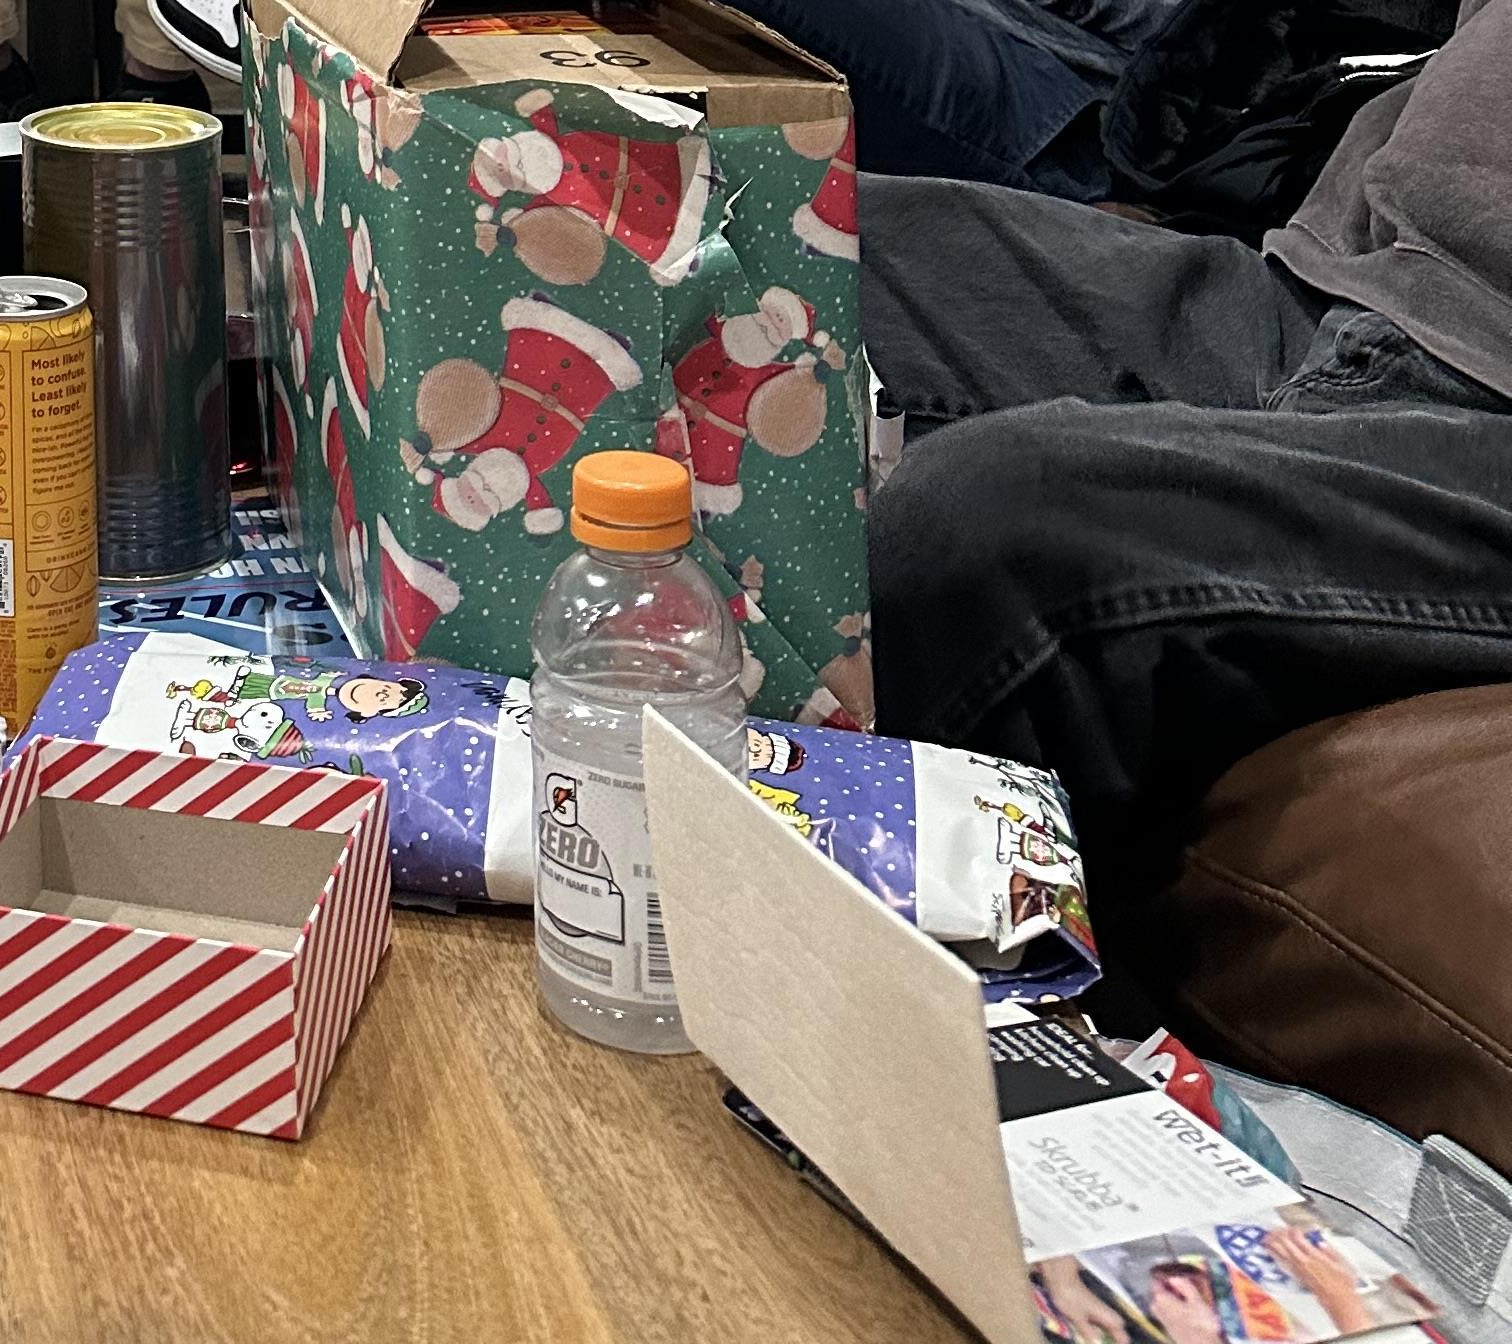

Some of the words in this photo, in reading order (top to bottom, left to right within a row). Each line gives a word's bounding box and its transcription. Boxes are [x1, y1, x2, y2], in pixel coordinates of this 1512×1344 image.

[31, 357, 60, 370] Most
[62, 349, 85, 366] likely
[31, 376, 44, 386] to
[47, 367, 86, 385] confuse.
[31, 388, 63, 402] Least
[65, 381, 87, 397] likely
[31, 407, 45, 418] to
[48, 400, 81, 416] forget.
[109, 588, 331, 625] RULES
[587, 772, 612, 787] ZERO
[538, 819, 601, 870] ZERO
[554, 870, 565, 885] MY
[565, 879, 589, 894] NAME
